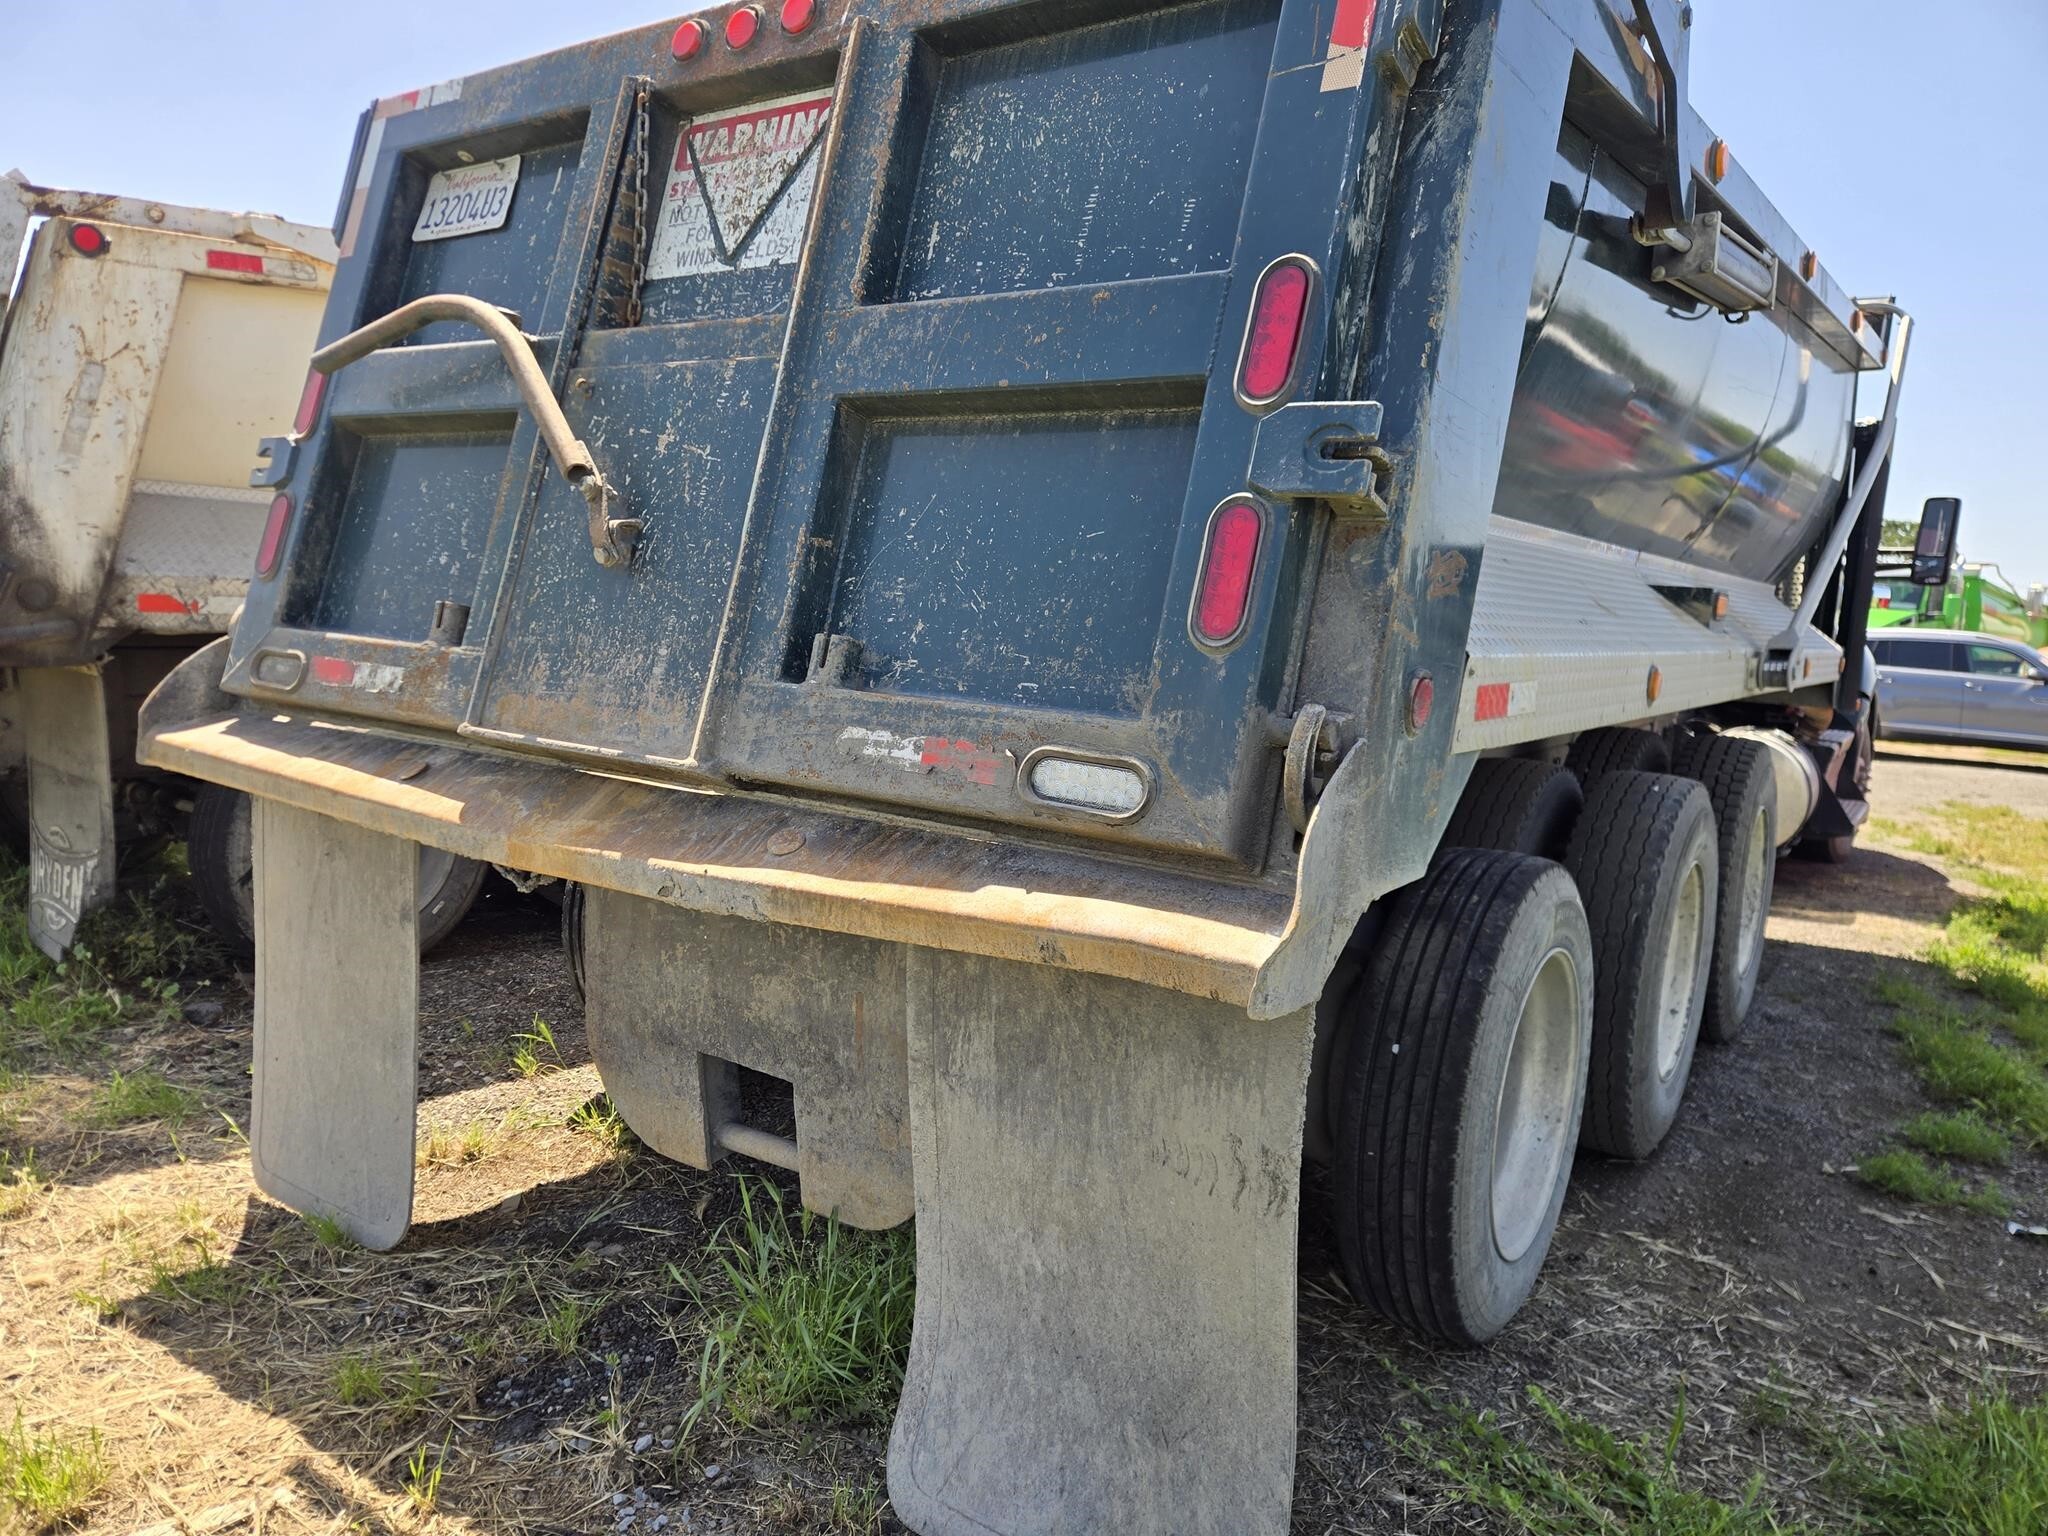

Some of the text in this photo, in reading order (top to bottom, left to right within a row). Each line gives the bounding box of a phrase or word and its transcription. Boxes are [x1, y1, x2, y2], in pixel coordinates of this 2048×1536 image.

[421, 186, 508, 229] 13204U3
[669, 203, 704, 224] NOT
[686, 223, 714, 244] FO
